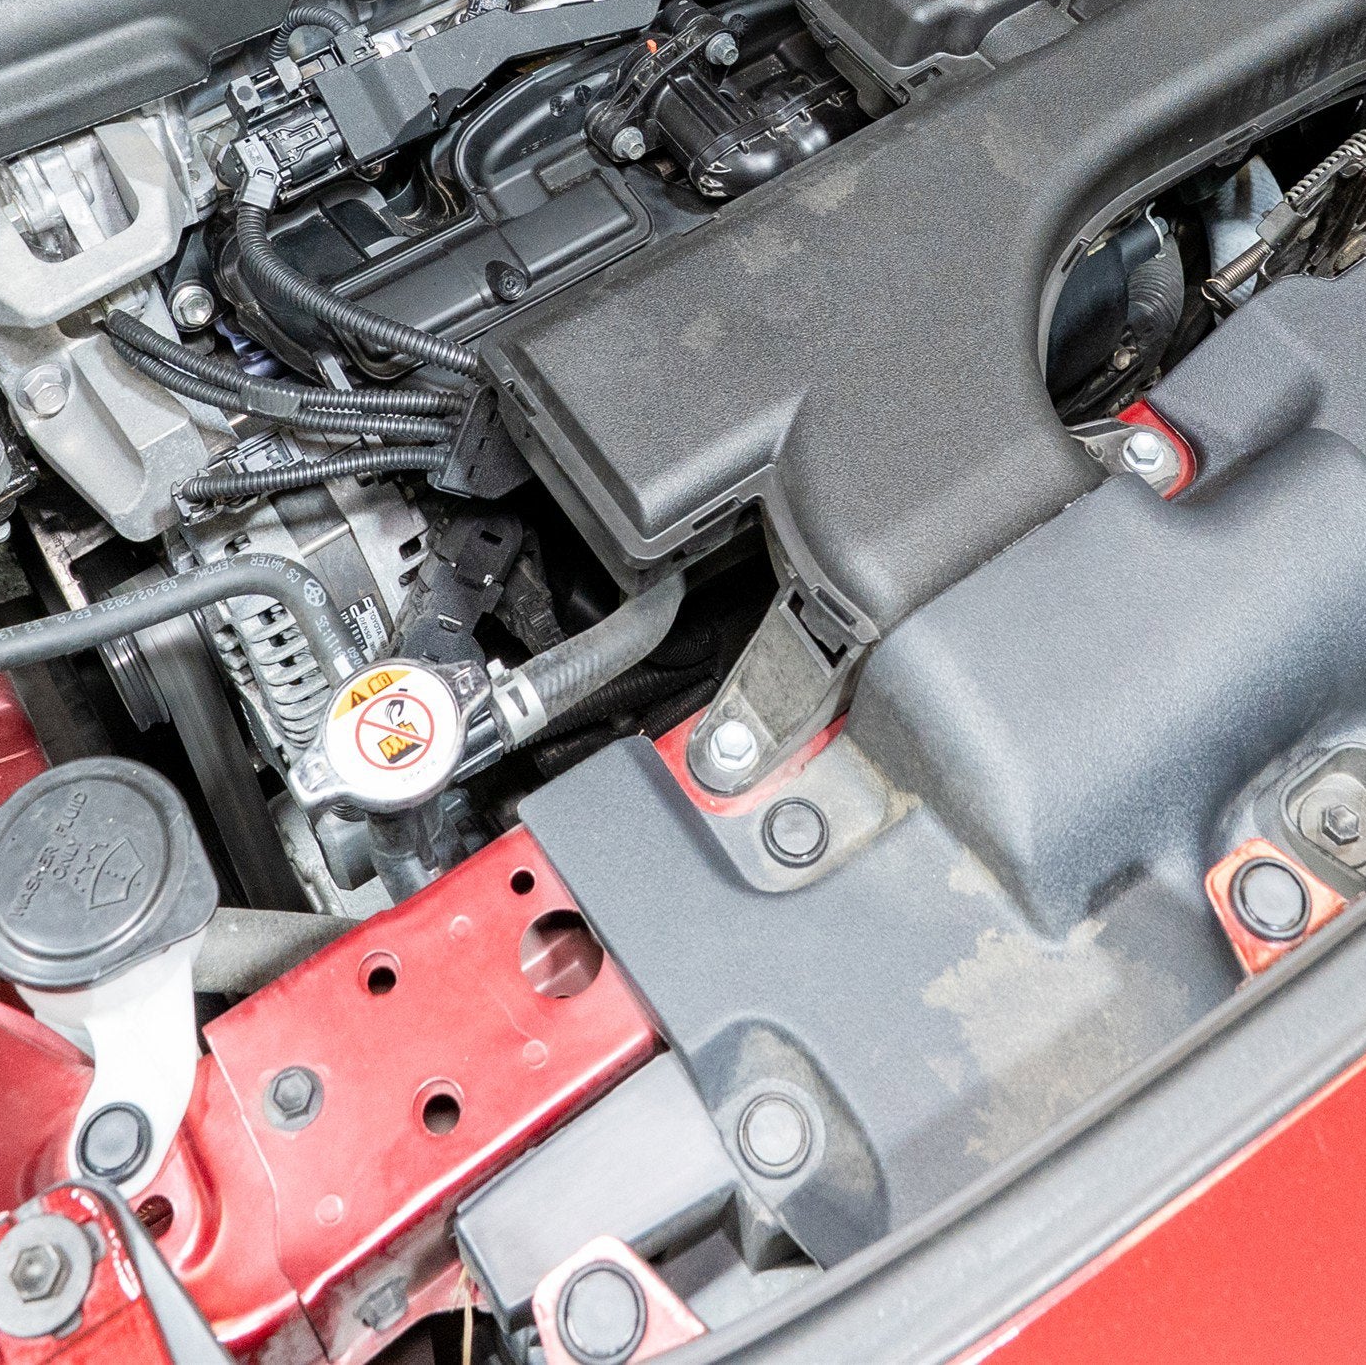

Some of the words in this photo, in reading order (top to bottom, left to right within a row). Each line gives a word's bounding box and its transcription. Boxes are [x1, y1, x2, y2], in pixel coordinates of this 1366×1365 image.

[249, 556, 285, 574] WATER
[359, 617, 373, 640] DENSO
[370, 611, 383, 636] TOYOTA
[9, 846, 59, 917] WASHER
[55, 792, 88, 837] FLUID
[53, 837, 81, 880] ONLY
